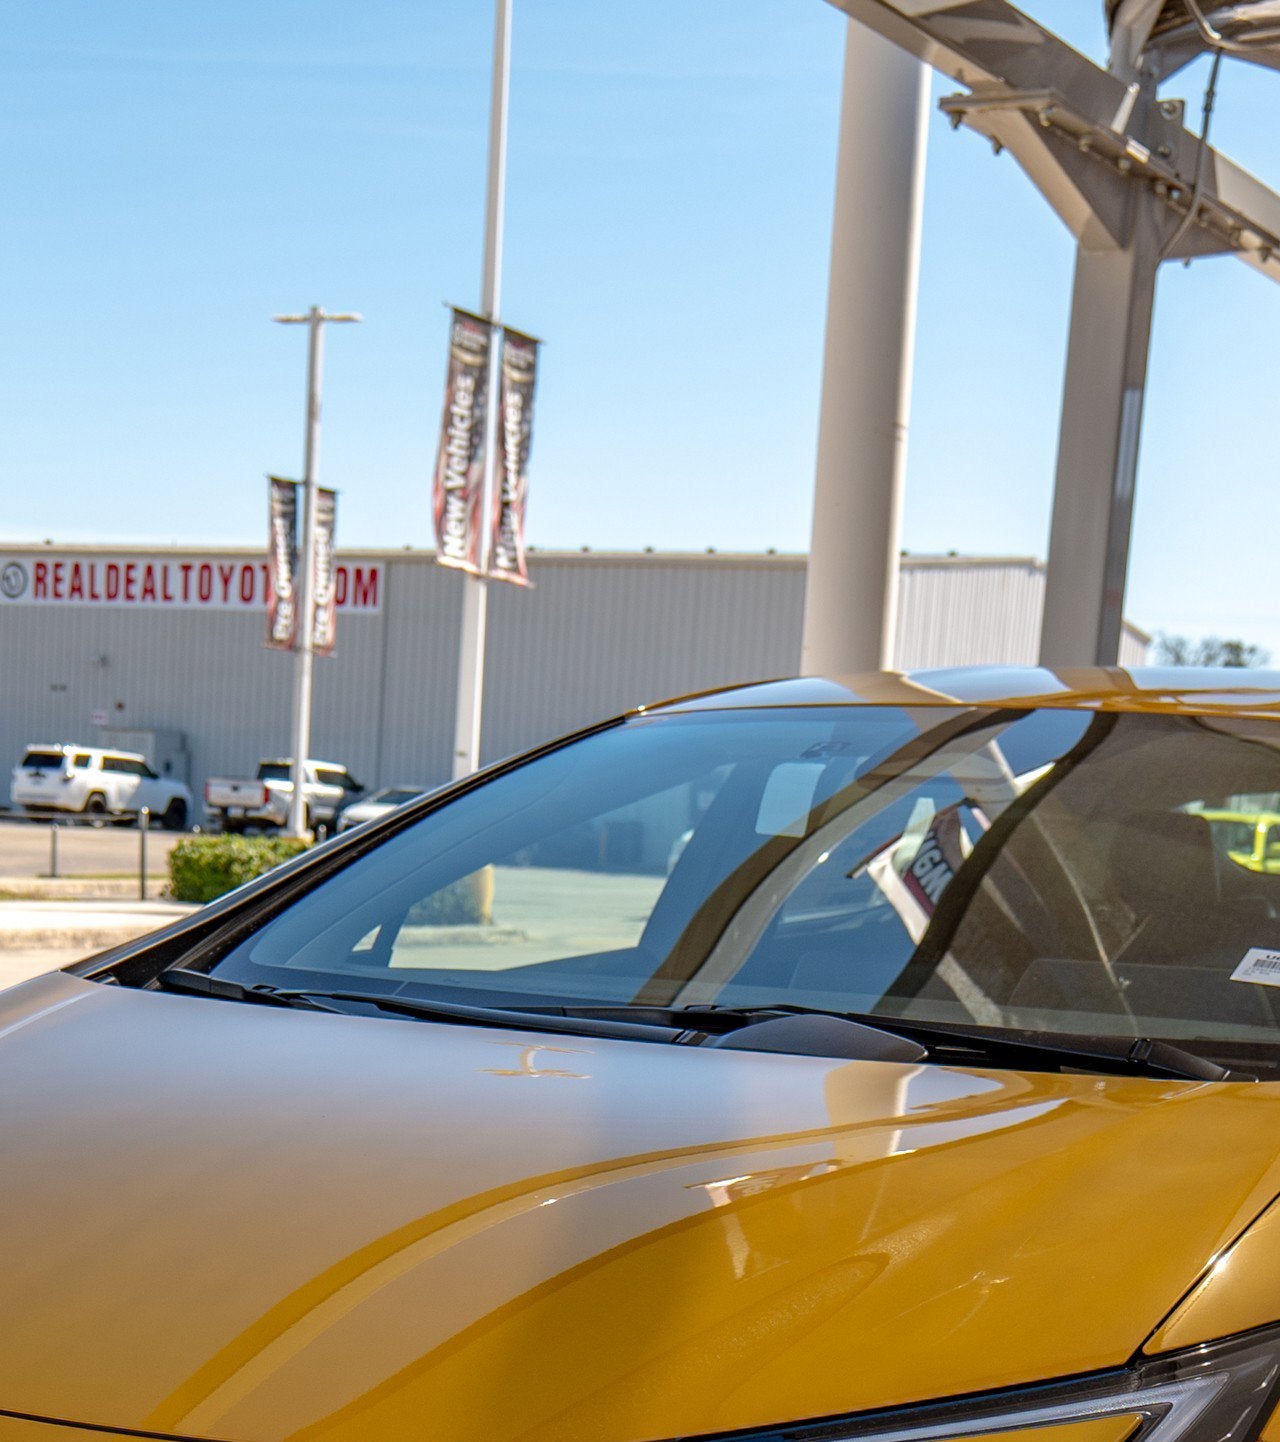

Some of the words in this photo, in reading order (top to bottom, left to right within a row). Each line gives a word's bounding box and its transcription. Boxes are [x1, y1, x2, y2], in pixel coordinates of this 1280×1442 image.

[444, 375, 475, 491] Vehicles
[442, 494, 467, 558] New
[272, 601, 295, 641] Pre
